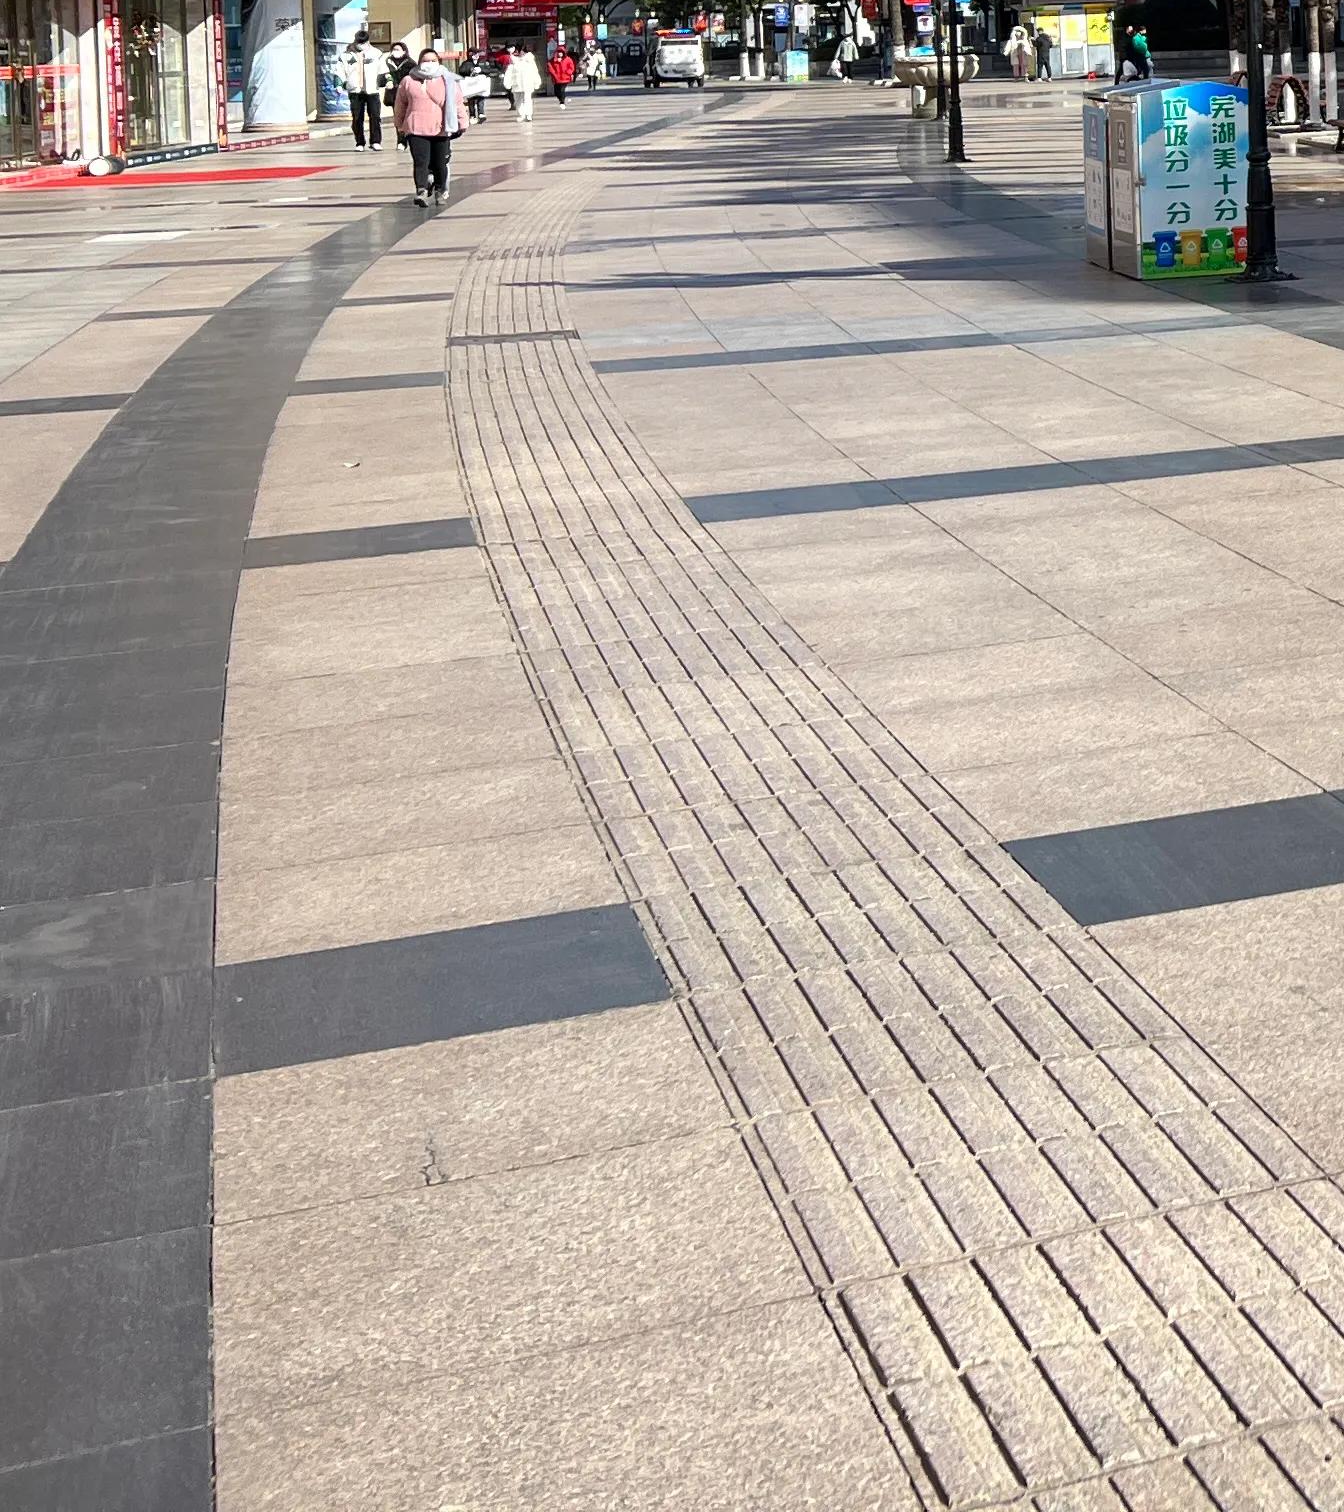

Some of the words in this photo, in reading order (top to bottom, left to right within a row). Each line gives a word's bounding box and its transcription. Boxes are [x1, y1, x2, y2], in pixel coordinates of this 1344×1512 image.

[1163, 98, 1191, 225] 垃圾分一分
[1211, 95, 1238, 222] 芜湖美十分
